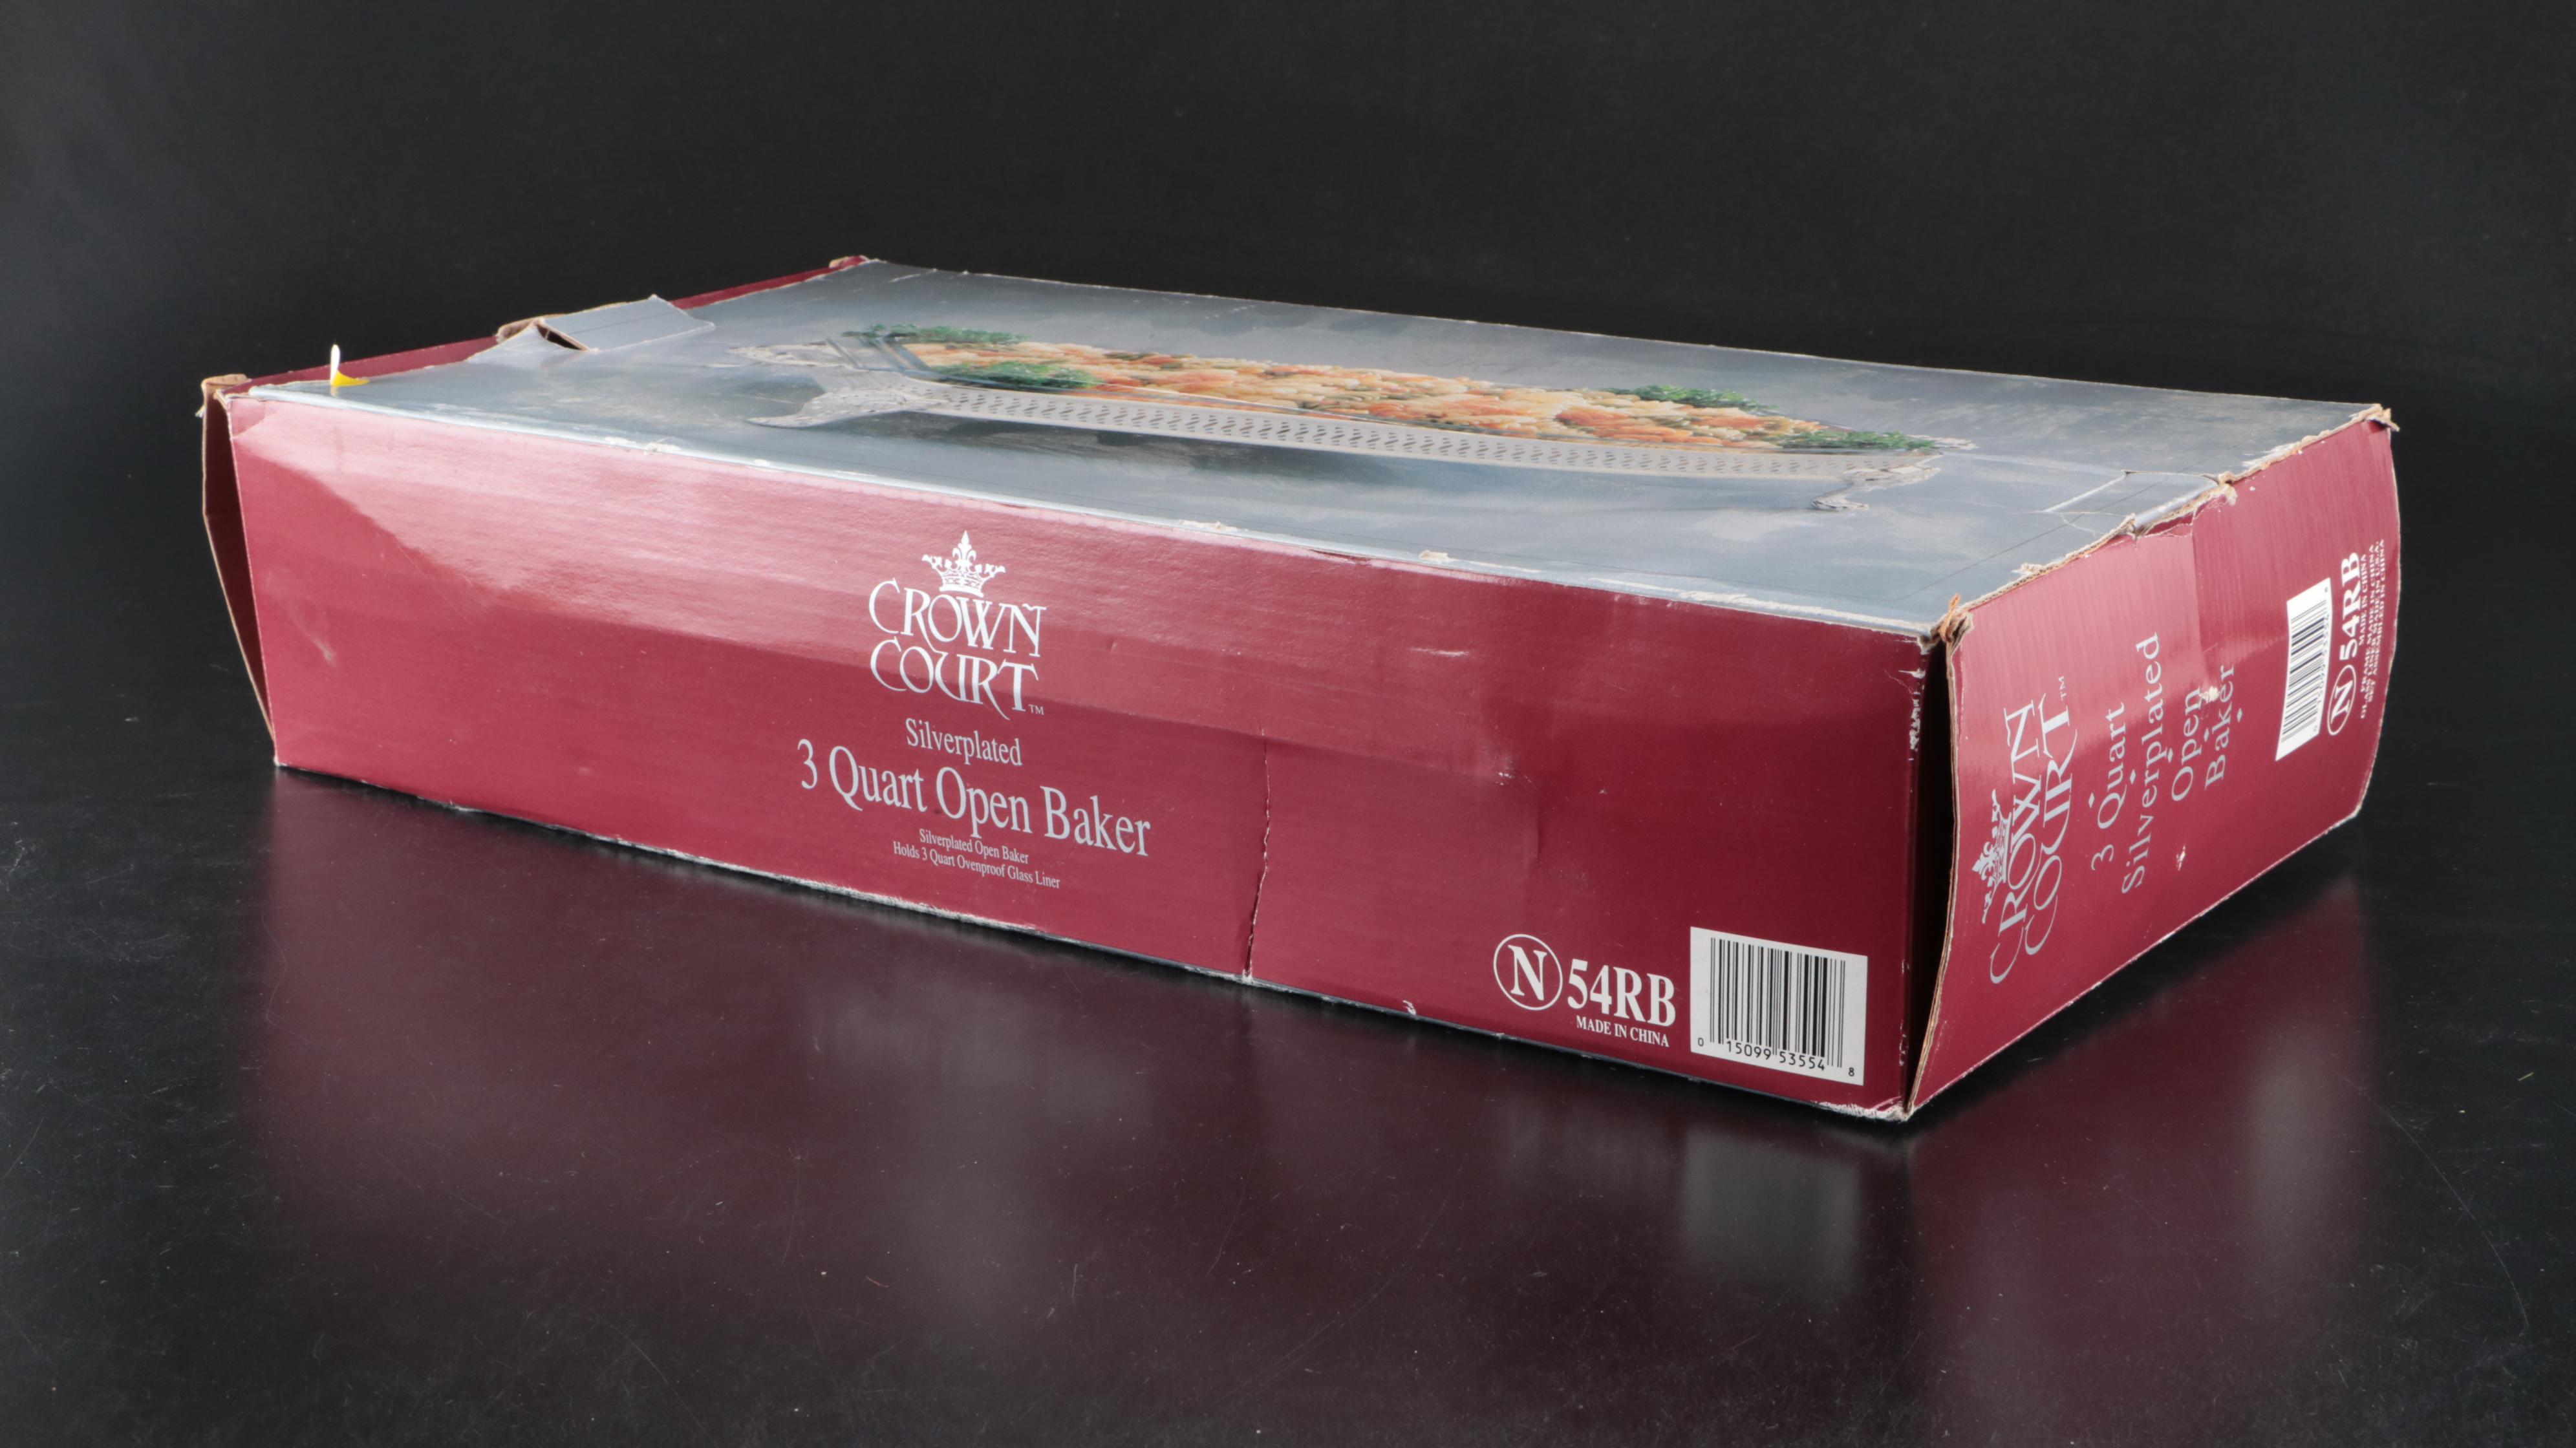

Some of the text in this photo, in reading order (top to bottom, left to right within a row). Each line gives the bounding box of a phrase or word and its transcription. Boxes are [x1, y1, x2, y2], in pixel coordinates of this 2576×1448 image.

[869, 577, 1047, 657] CROWN
[2359, 610, 2367, 645] MADE
[2361, 596, 2368, 608] IN
[2370, 590, 2376, 604] IN
[870, 637, 1038, 719] COURT
[2331, 553, 2360, 724] N 54RB
[905, 718, 1022, 767] Silverplated
[2121, 632, 2166, 895] Silverplated
[2171, 685, 2204, 802] Open
[2204, 665, 2235, 790] Baker
[797, 739, 1151, 857] 3 Quart Open Baker
[2024, 694, 2077, 955] COURT
[2090, 702, 2127, 870] 3 Quart
[893, 841, 1060, 889] Holds 3 Quart Ovenproof Glass Liner
[919, 829, 1029, 864] Silverplated Open Baker
[1990, 700, 2044, 985] CROWN
[1508, 944, 1676, 1028] N 54RB
[1576, 1015, 1669, 1048] MADE IN CHINA
[1697, 1037, 1854, 1077] 0 15099 53554 8
